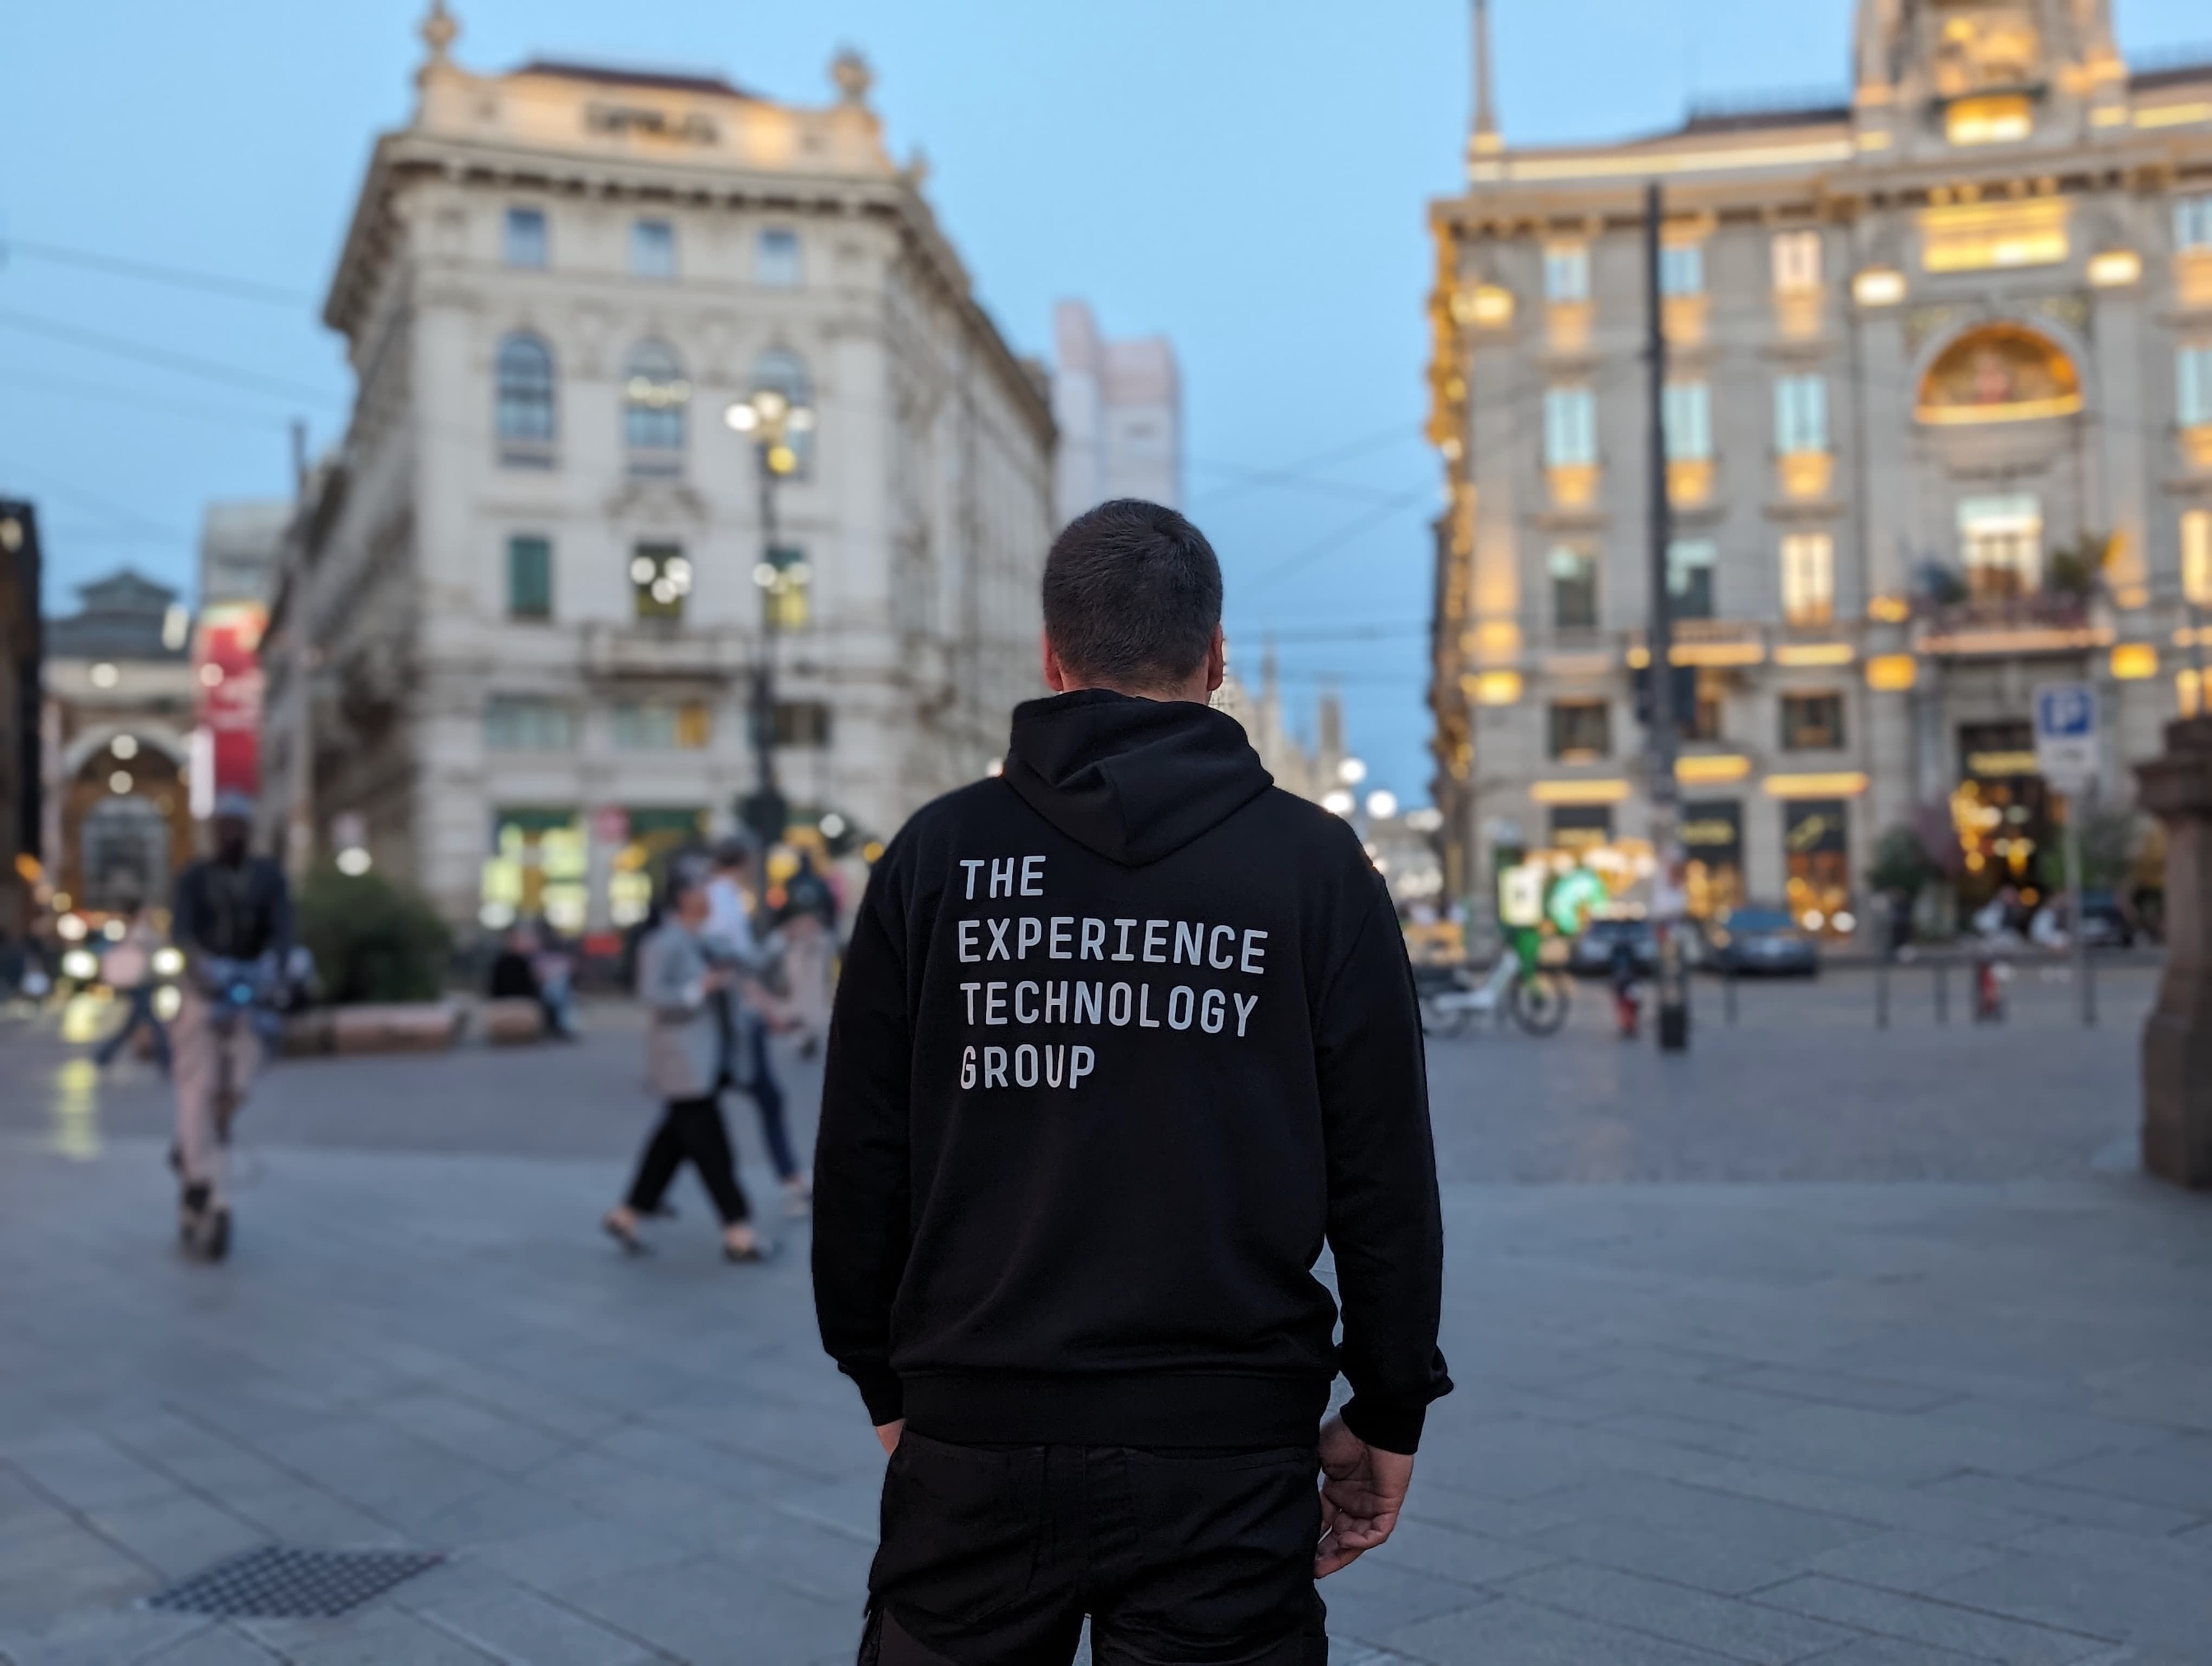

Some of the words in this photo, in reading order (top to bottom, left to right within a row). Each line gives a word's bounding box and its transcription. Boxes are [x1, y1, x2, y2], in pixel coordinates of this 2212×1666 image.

[959, 855, 1046, 900] THE
[958, 916, 1269, 974] EXPERIENCE
[959, 979, 1259, 1037] TECHNOLOGY
[960, 1044, 1096, 1090] GROUP
